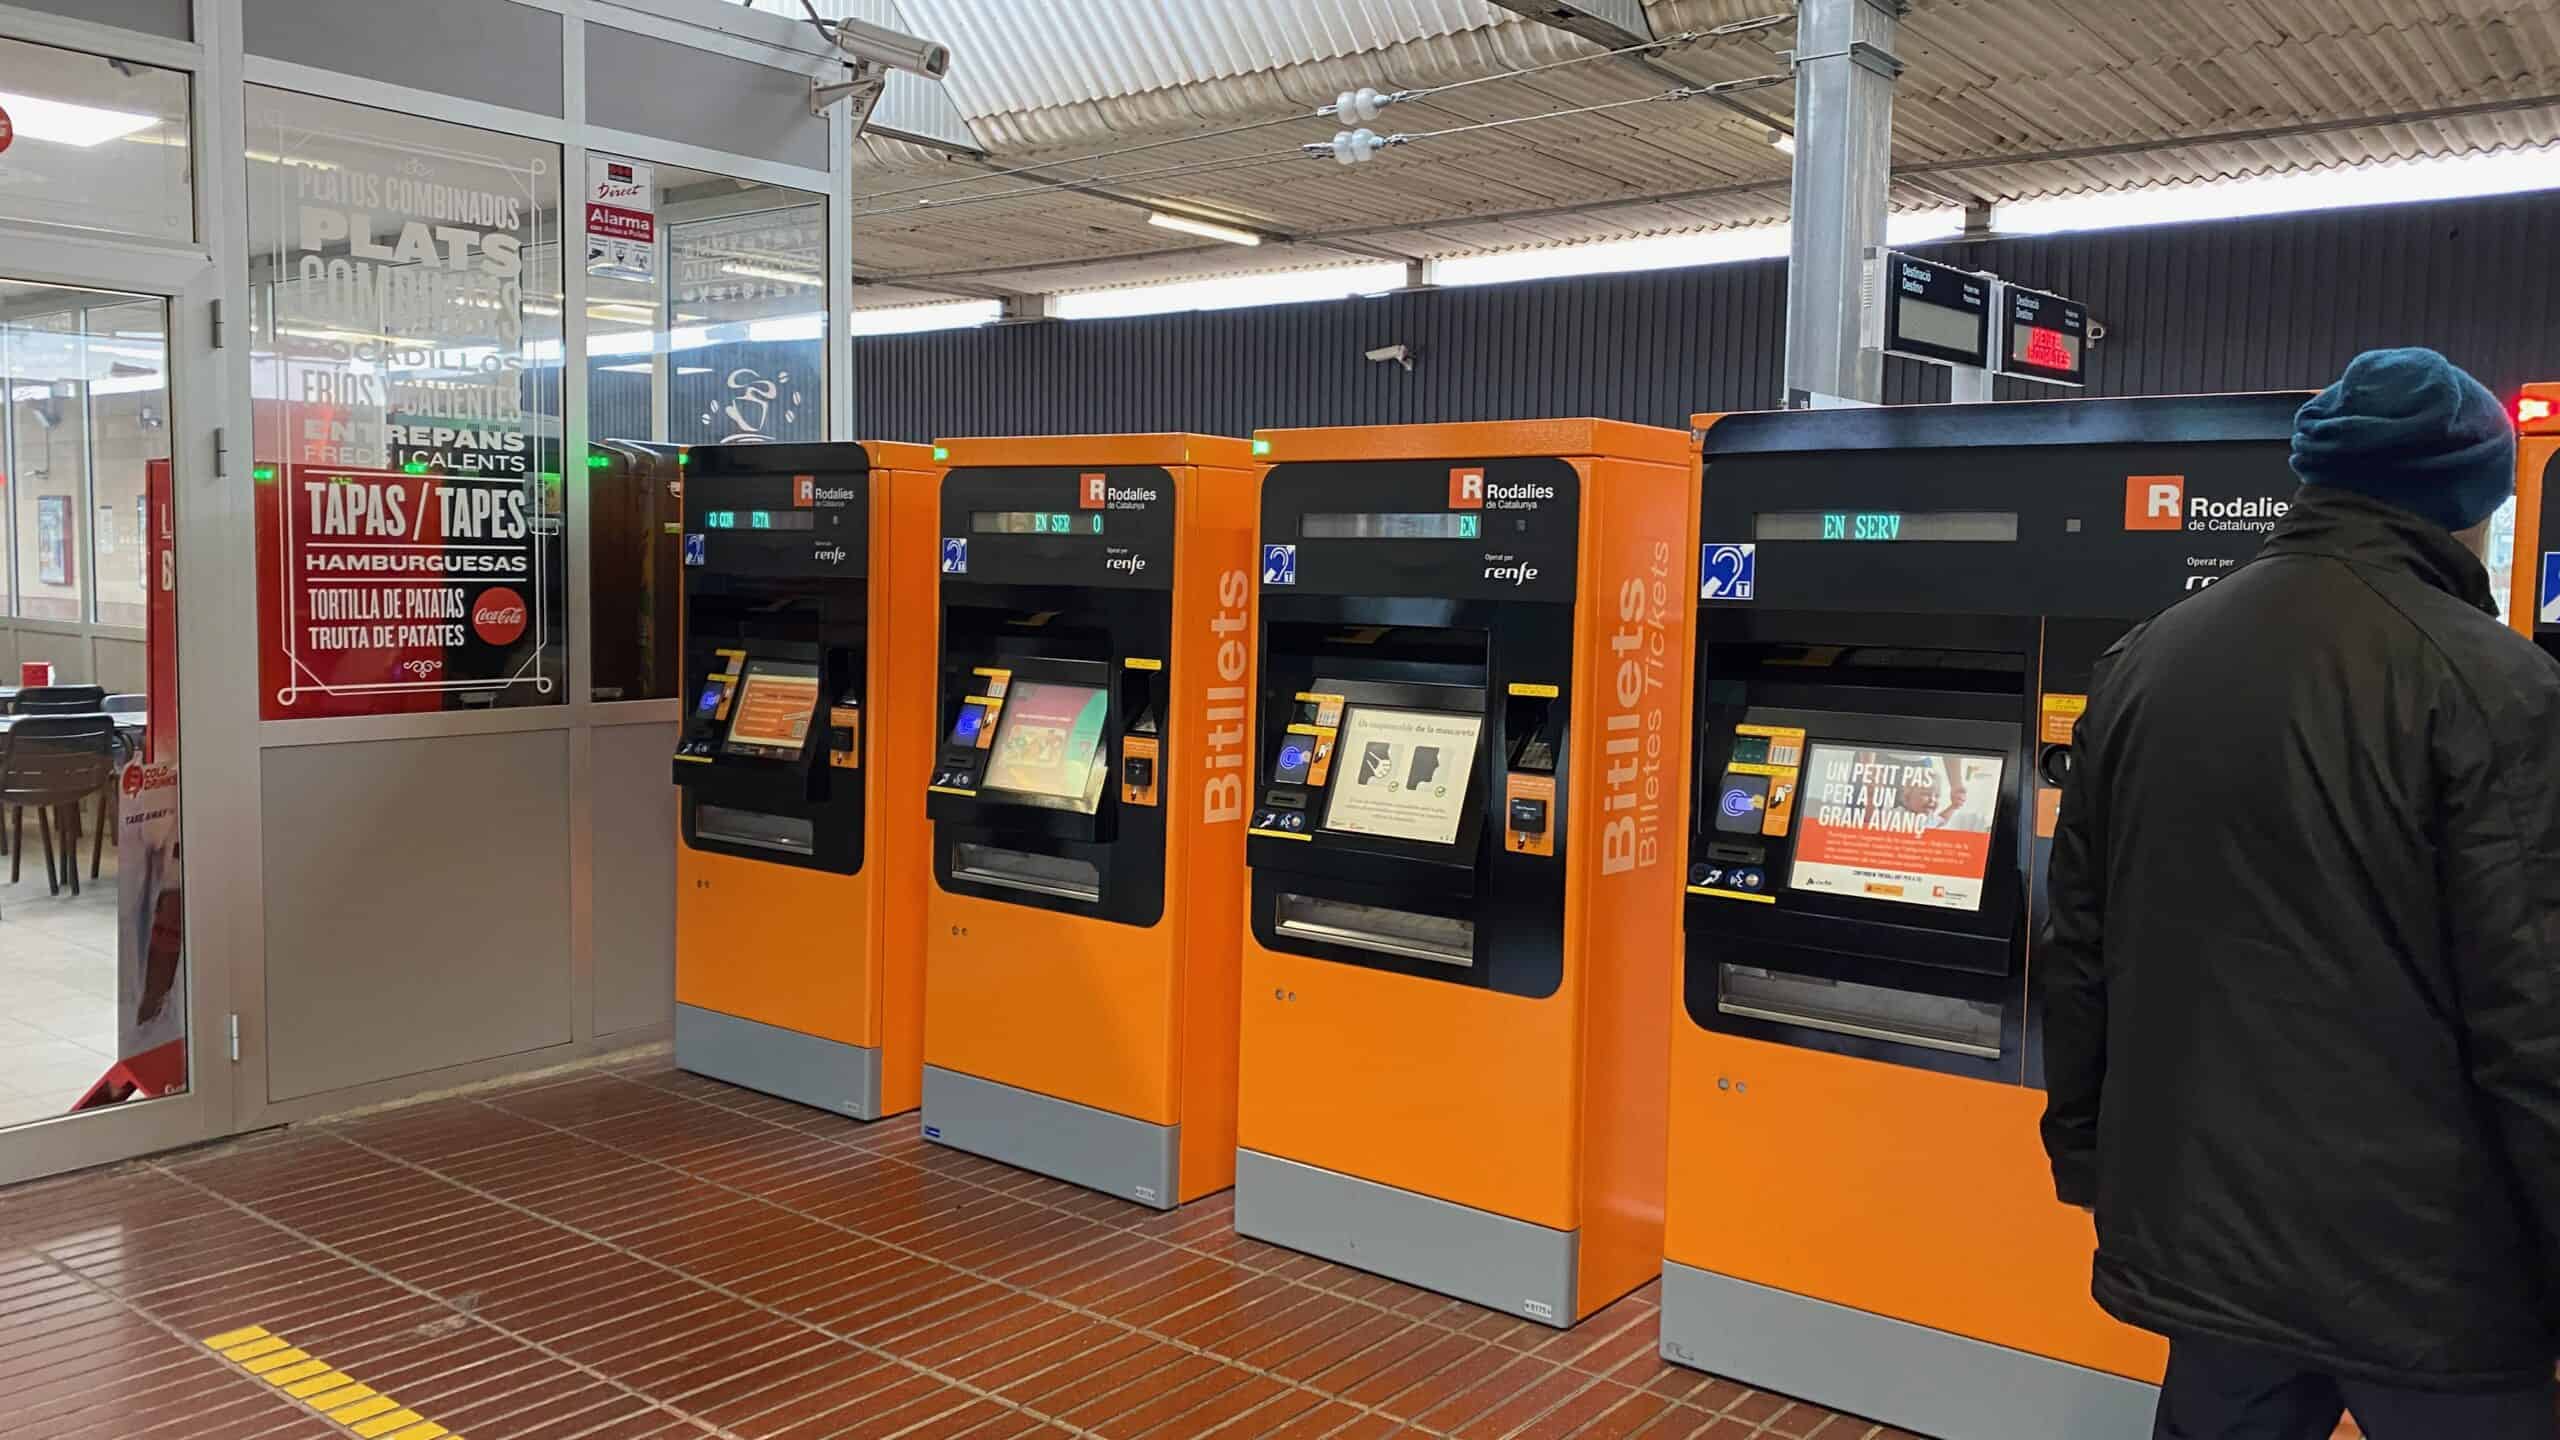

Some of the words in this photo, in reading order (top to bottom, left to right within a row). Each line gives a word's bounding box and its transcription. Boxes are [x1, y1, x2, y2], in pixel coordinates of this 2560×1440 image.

[299, 164, 379, 208] PLATOS
[385, 176, 520, 231] COMBINADOS
[591, 208, 650, 231] Alarma
[302, 207, 522, 277] PLATS
[304, 419, 526, 452] ENTREPANS
[304, 445, 391, 467] FREDS
[411, 449, 526, 472] CALENTS
[815, 487, 855, 500] Rodalies
[1108, 487, 1157, 501] Rodalies
[1487, 483, 1554, 500] Rodalies
[304, 482, 407, 537] TAPAS
[412, 482, 430, 541] /
[435, 487, 526, 539] TAPES
[1485, 500, 1497, 509] de
[1498, 500, 1538, 511] Catalunya
[2190, 496, 2293, 518] Rodalie
[1034, 512, 1048, 532] EN
[1823, 514, 1847, 540] EN
[1855, 514, 1901, 541] SERV
[2188, 519, 2206, 531] de
[2208, 519, 2276, 534] Catalunya
[306, 554, 528, 572] HAMBURGUESAS
[815, 546, 847, 565] renfe
[1106, 554, 1146, 576] renfe
[2186, 556, 2217, 568] Operat
[2218, 558, 2235, 568] per
[1483, 561, 1538, 586] renfe
[308, 588, 382, 621] TORTILLA
[383, 588, 402, 620] DE
[406, 588, 465, 619] PATATAS
[1644, 541, 1671, 695] Tickets
[308, 626, 369, 650] TRUITA
[373, 626, 394, 648] DE
[398, 624, 465, 648] PATATES
[1204, 568, 1249, 825] Bitllets
[1601, 576, 1646, 876] Bitllets
[1826, 760, 1850, 782] UN
[1852, 762, 1900, 786] PETIT
[1901, 765, 1934, 788] PAS
[1638, 707, 1663, 868] Billetes
[1823, 783, 1855, 805] PER
[1856, 786, 1869, 807] A
[1872, 786, 1897, 809] UN
[126, 812, 145, 825] TAKE
[145, 808, 168, 821] AWAY
[1817, 804, 1867, 830] GRAN
[1867, 808, 1930, 839] AVANÇ
